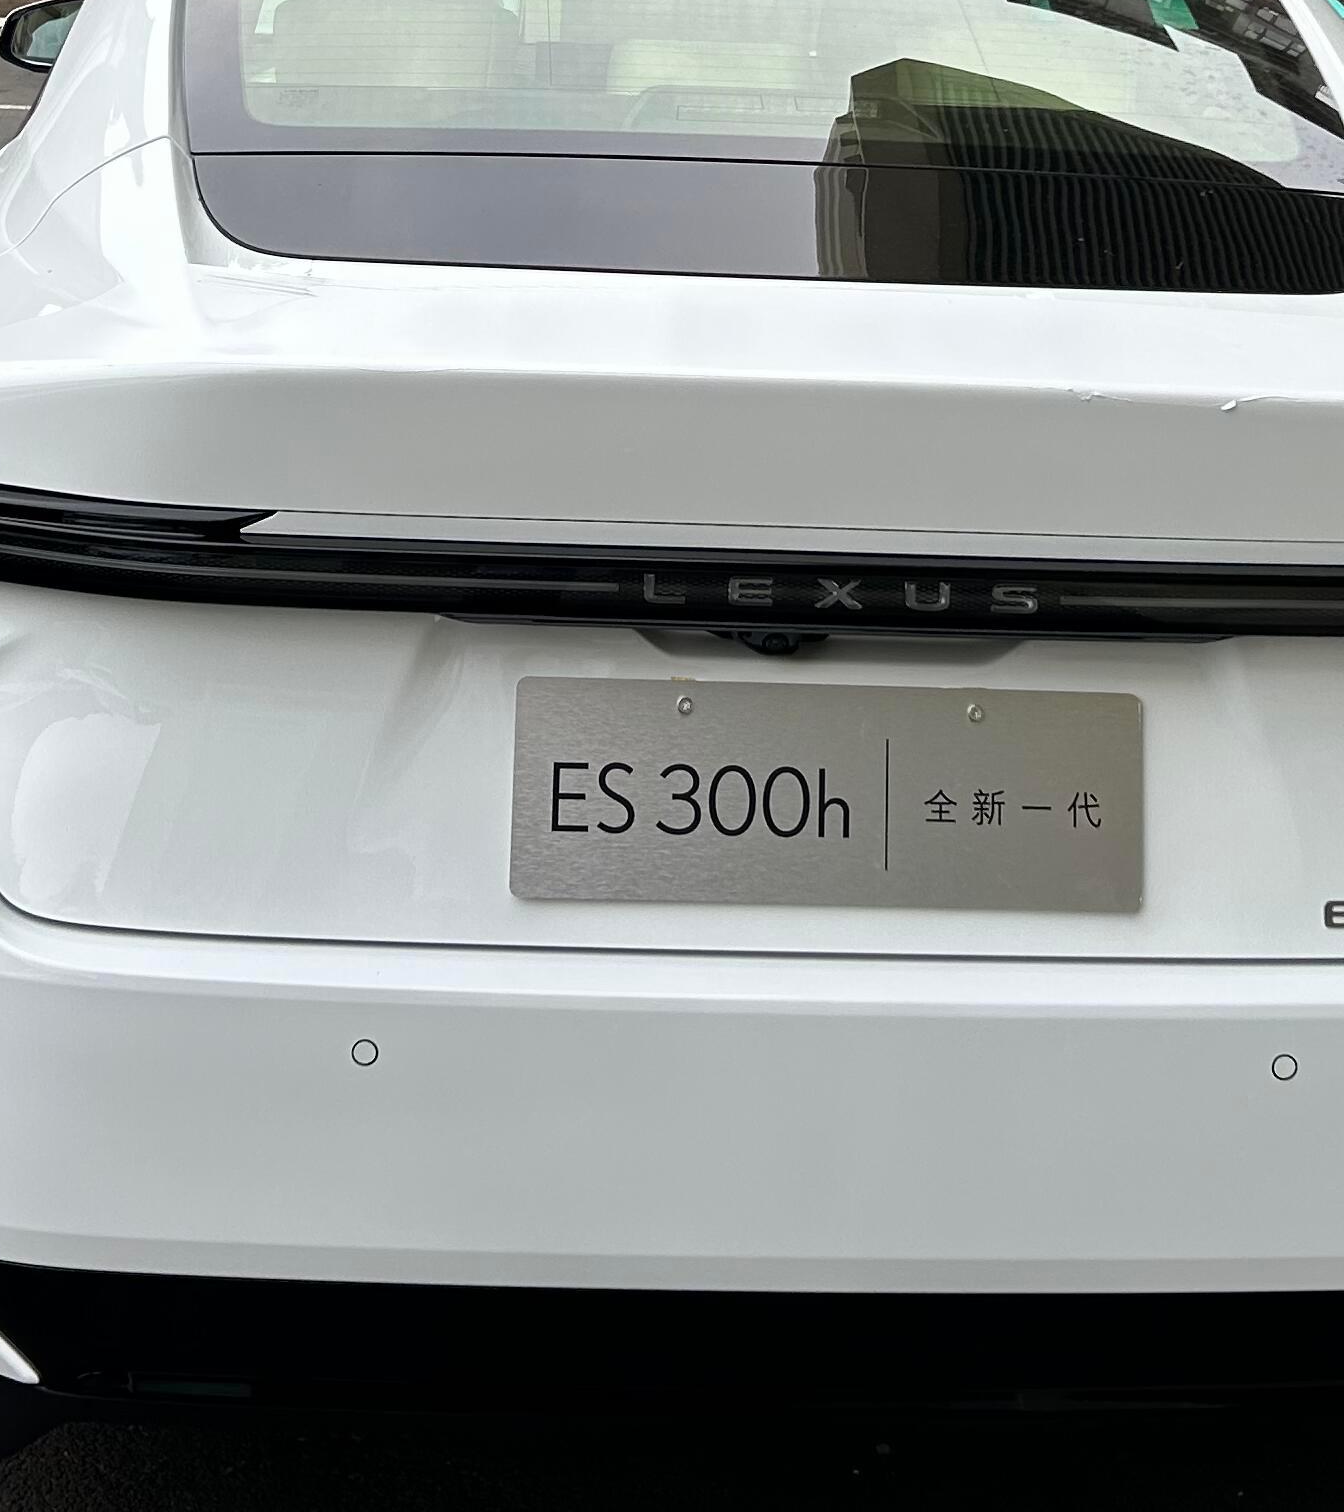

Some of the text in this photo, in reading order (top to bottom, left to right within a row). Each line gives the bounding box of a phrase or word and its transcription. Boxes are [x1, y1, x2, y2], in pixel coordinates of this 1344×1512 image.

[643, 572, 1038, 614] LEXUS
[550, 761, 1102, 838] ES 300h 全新一代
